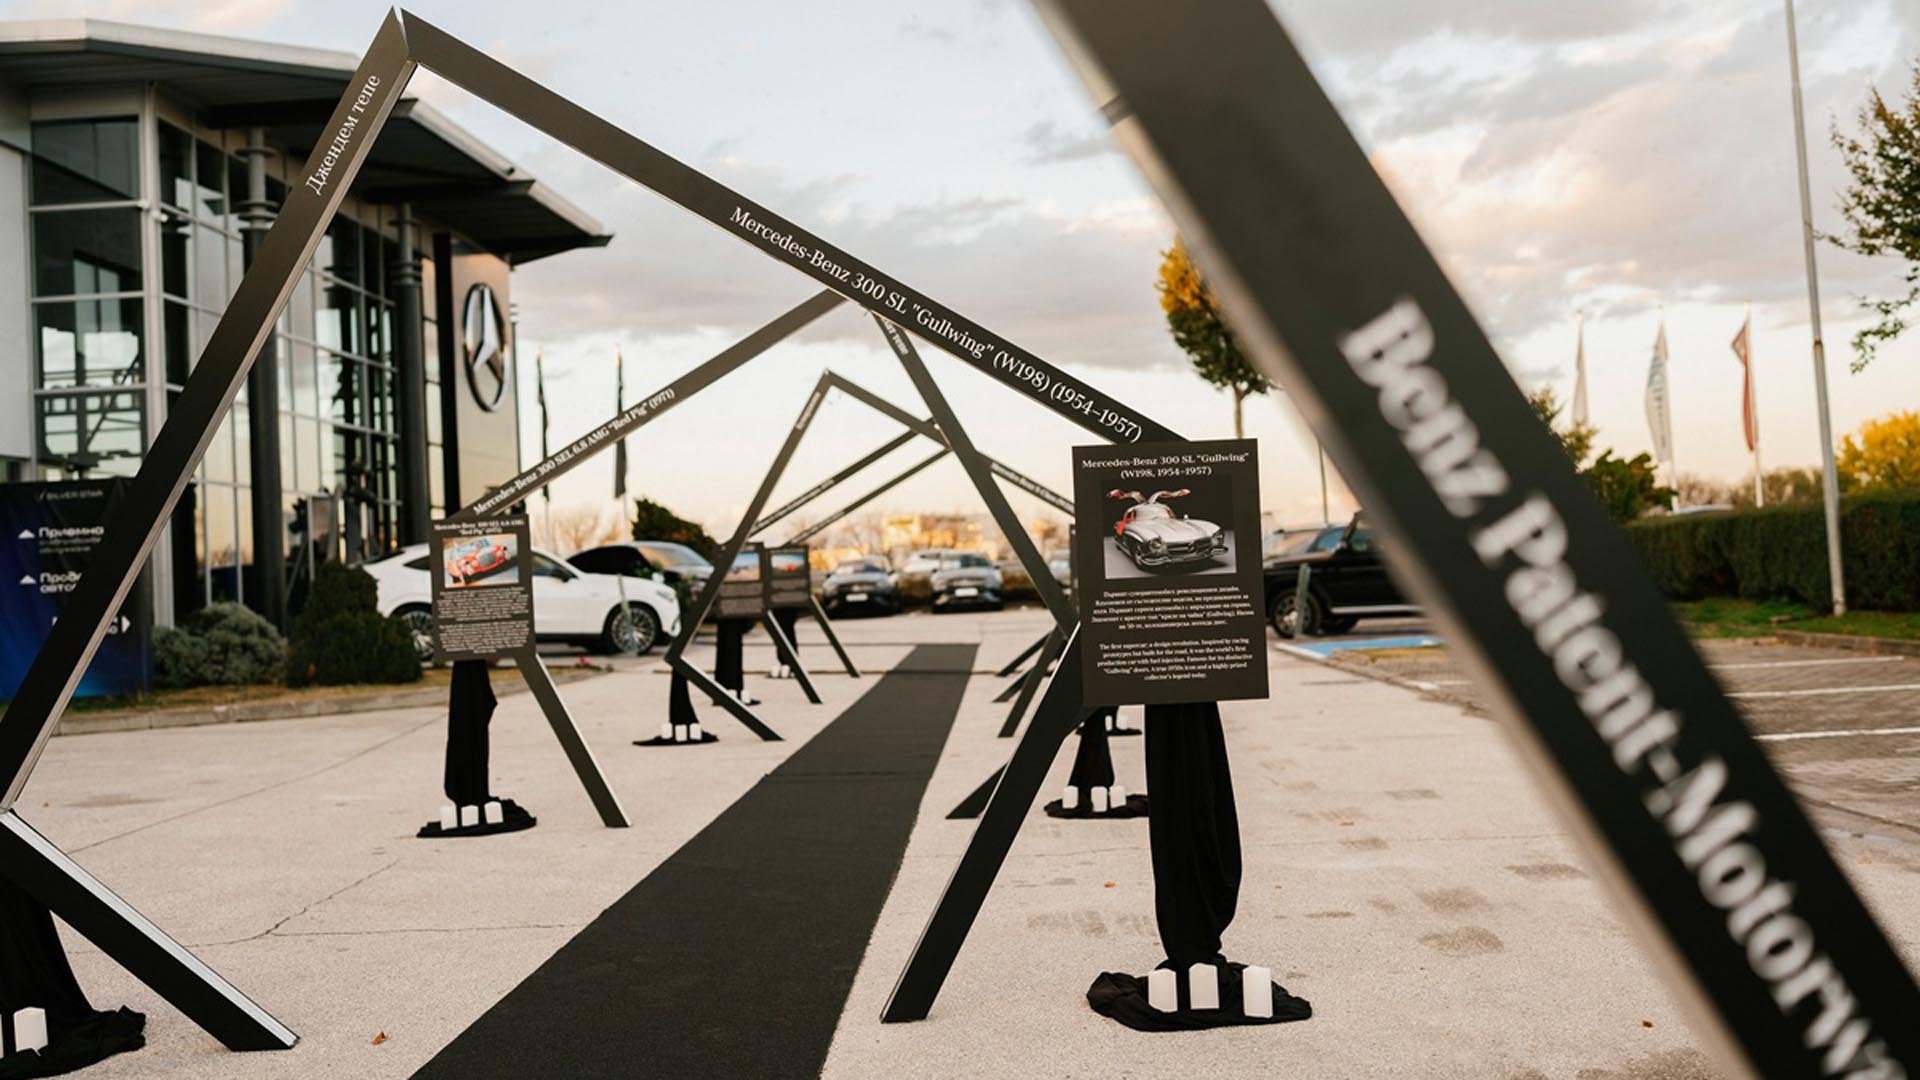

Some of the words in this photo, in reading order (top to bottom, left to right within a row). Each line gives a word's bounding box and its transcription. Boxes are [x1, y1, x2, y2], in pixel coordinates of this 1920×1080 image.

[305, 115, 359, 196] Джендем
[352, 75, 381, 113] тепе
[729, 206, 851, 283] Mercedes-Benz
[851, 272, 886, 300] 300
[885, 291, 908, 315] SL
[912, 303, 995, 360] "Gullwing"
[992, 350, 1050, 393] (W198)
[1336, 294, 1512, 520] Benz
[472, 472, 538, 516] Mercedes-Benz
[538, 460, 556, 477] 300
[555, 451, 575, 467] SEL
[587, 427, 610, 446] AMG
[1082, 456, 1158, 468] Mercedes-Benz
[1159, 455, 1180, 465] 300
[1181, 455, 1195, 464] SL
[1120, 469, 1156, 479] (W198,
[38, 526, 104, 539] Приемна
[40, 583, 77, 594] авто
